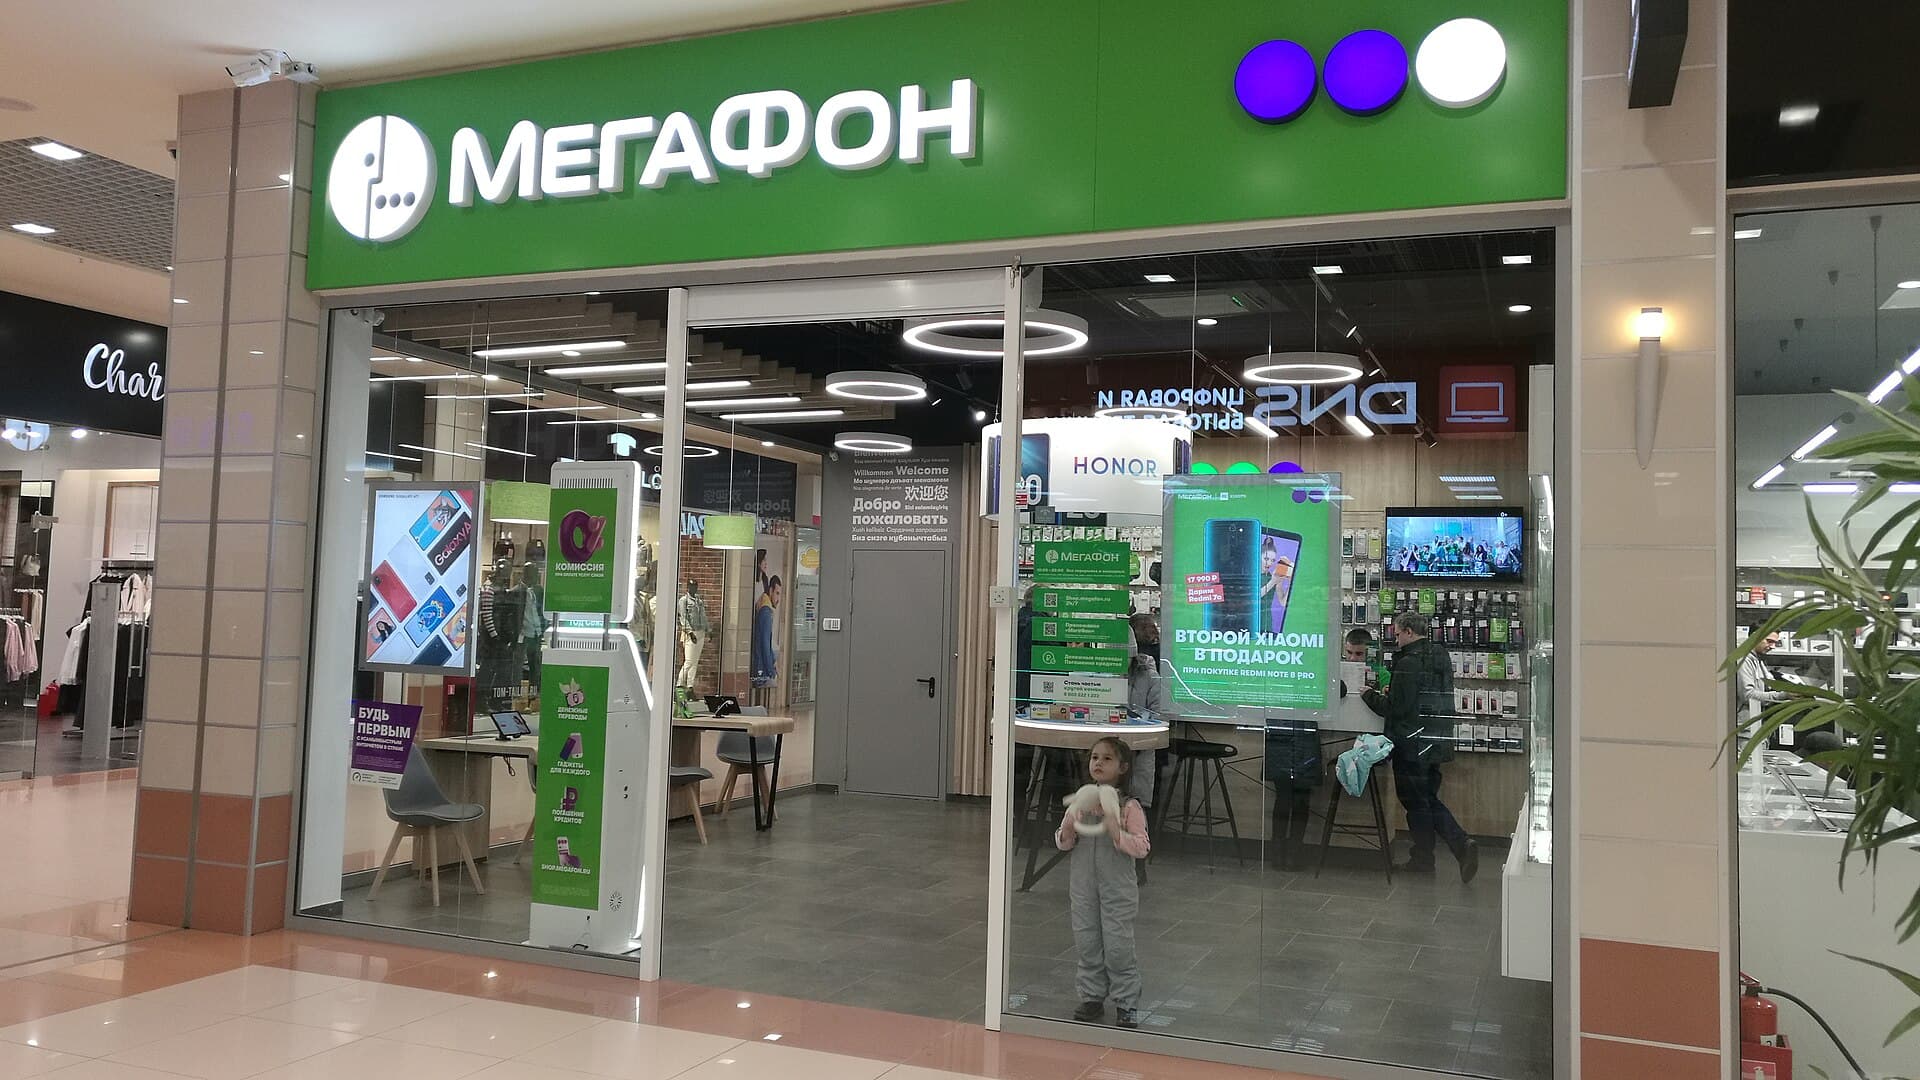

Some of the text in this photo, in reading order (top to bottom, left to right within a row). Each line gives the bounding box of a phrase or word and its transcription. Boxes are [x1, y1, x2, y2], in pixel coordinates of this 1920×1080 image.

[449, 79, 976, 206] МЕГАФОН
[896, 466, 949, 475] Welcome
[1074, 457, 1157, 477] HONOR
[904, 484, 949, 501] 欢迎您
[853, 497, 901, 512] Добро
[852, 514, 948, 525] пожаловать
[555, 562, 605, 572] КОМИССИЯ
[1175, 629, 1324, 648] ВТОРОЙ XIAOMI
[1194, 648, 1304, 665] В ПОДАРОК
[1201, 667, 1239, 676] ПОКУПКЕ
[1240, 669, 1266, 677] REDMI
[1267, 670, 1288, 678] NOTE
[1298, 672, 1315, 680] PRO
[358, 706, 390, 722] БУДЬ
[357, 722, 411, 738] ПЕРВЫМ
[557, 761, 584, 769] ГАДЖЕТЫ
[562, 768, 591, 776] КАЖДОГО
[552, 809, 585, 818] ПОГАШЕНИЕ
[554, 816, 582, 824] КРЕДИТОВ
